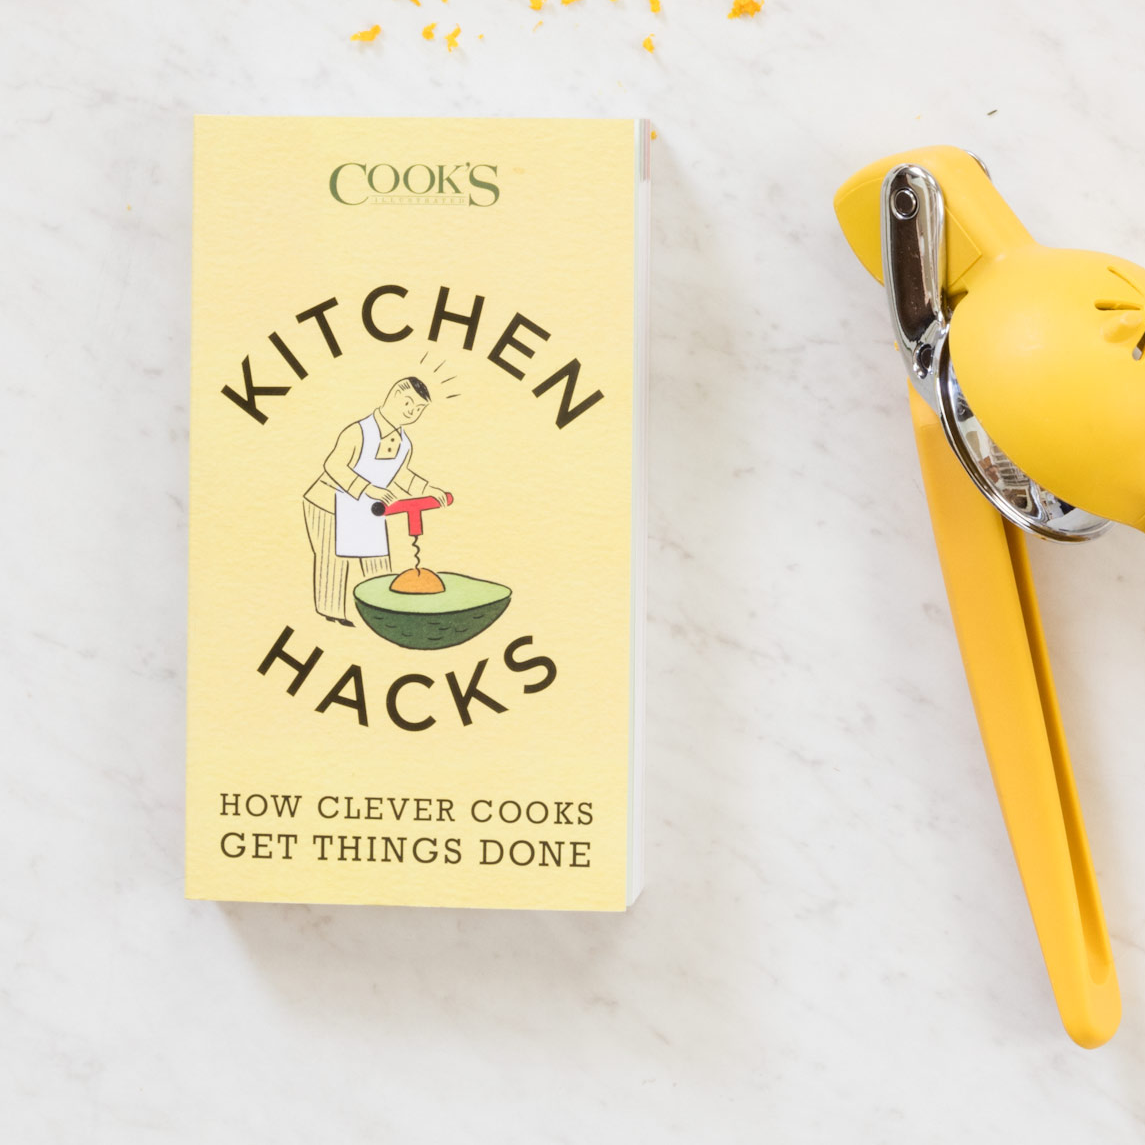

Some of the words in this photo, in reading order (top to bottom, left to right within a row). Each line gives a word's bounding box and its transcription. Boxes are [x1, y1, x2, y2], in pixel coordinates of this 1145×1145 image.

[329, 162, 500, 207] COOK'S
[221, 284, 604, 430] KITCHEN
[256, 625, 557, 732] HACKS
[220, 793, 303, 818] HOW
[317, 796, 456, 822] CLEVER
[470, 800, 594, 826] COOKS
[220, 832, 298, 860] GET
[313, 835, 462, 865] THINGS
[479, 839, 591, 868] DONE
